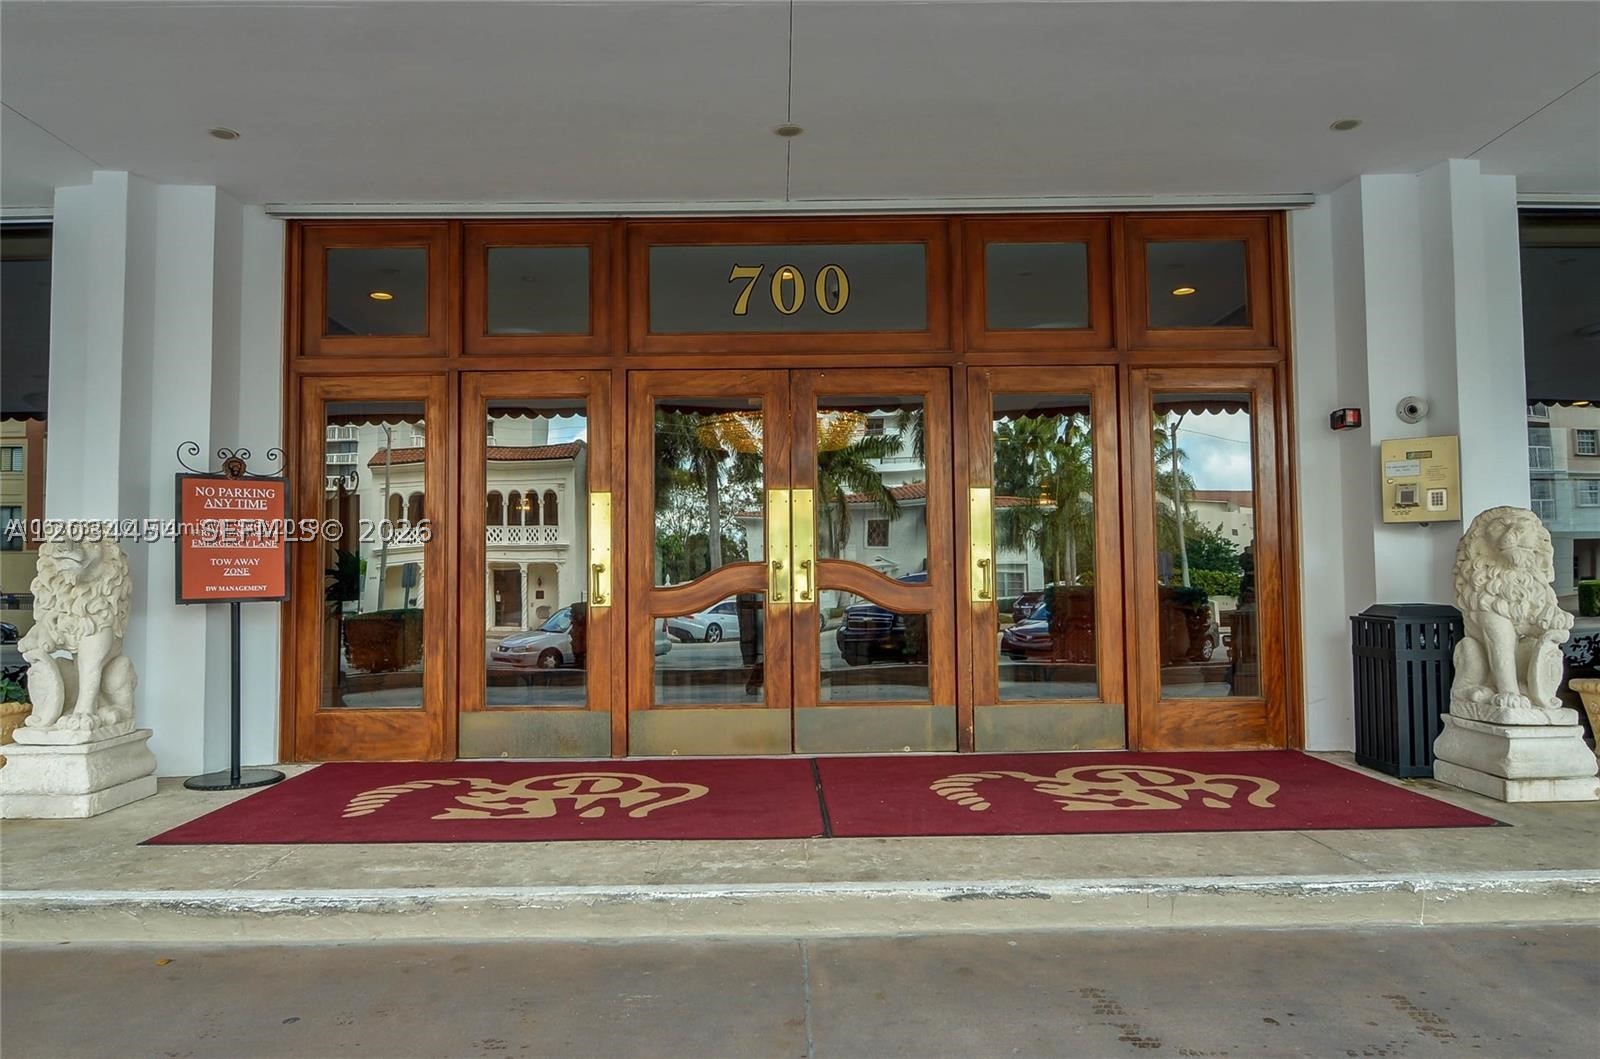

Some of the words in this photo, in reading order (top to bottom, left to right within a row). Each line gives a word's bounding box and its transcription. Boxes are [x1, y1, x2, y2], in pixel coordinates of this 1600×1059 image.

[729, 263, 850, 316] 700
[195, 487, 215, 497] NO
[219, 488, 275, 498] PARKING
[204, 498, 233, 508] ANY
[235, 500, 267, 509] TIME
[210, 558, 232, 566] TOW
[234, 558, 260, 566] AWAY
[223, 568, 250, 576] ZONE
